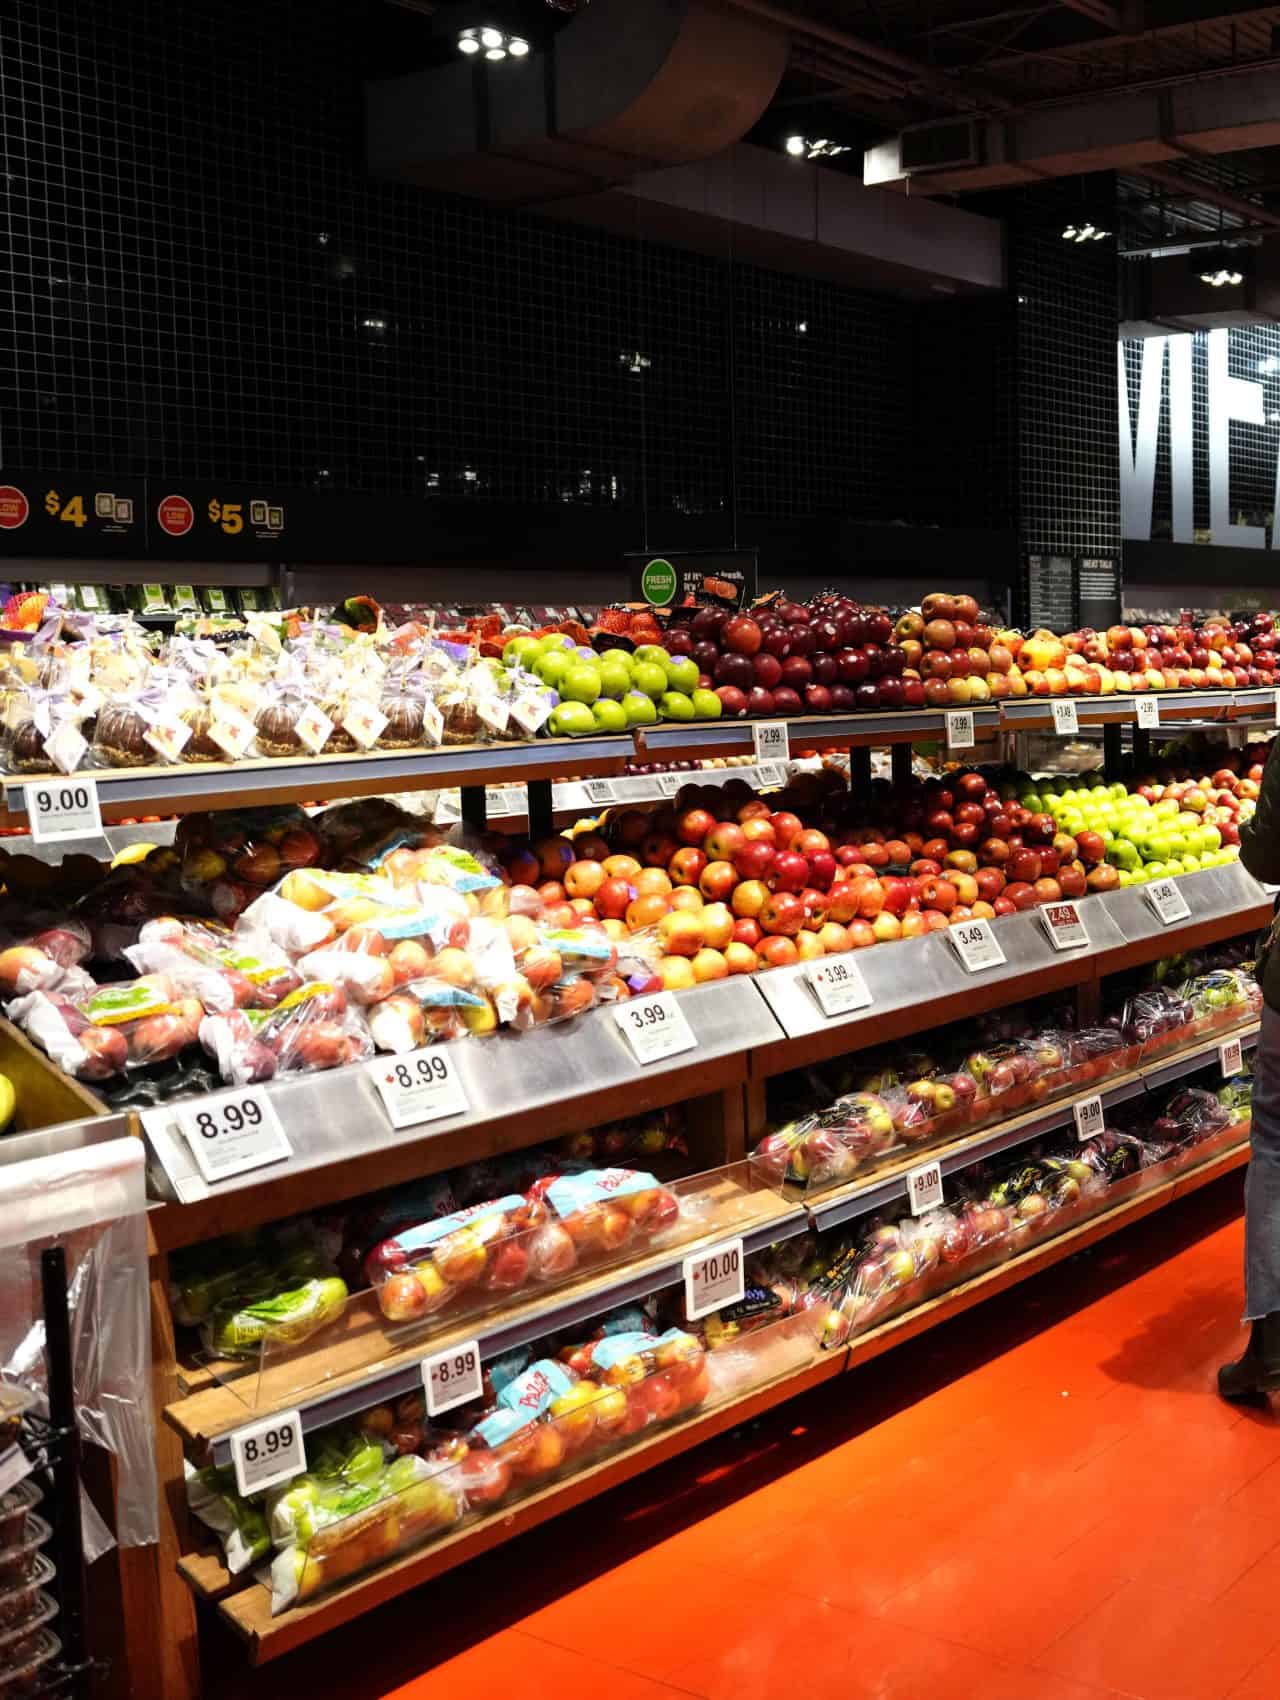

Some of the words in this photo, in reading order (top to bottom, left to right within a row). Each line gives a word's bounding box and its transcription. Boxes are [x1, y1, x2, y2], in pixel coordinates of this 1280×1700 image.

[44, 489, 88, 528] $4
[208, 498, 244, 535] $5
[646, 575, 672, 585] FRESH
[954, 717, 968, 730] 2.99
[764, 728, 780, 744] 2.99
[37, 787, 89, 812] 9.00
[1153, 886, 1172, 901] 3.49
[958, 927, 983, 945] 3.49
[825, 964, 848, 983] 3.99
[631, 1004, 665, 1028] 3.99
[395, 1056, 448, 1088] 8.99
[196, 1099, 262, 1139] 8.99
[1082, 1101, 1101, 1120] 9.00
[918, 1169, 939, 1191] 9.00
[701, 1250, 739, 1284] 10.00
[439, 1351, 475, 1382] 8.99
[245, 1425, 293, 1461] 8.99
